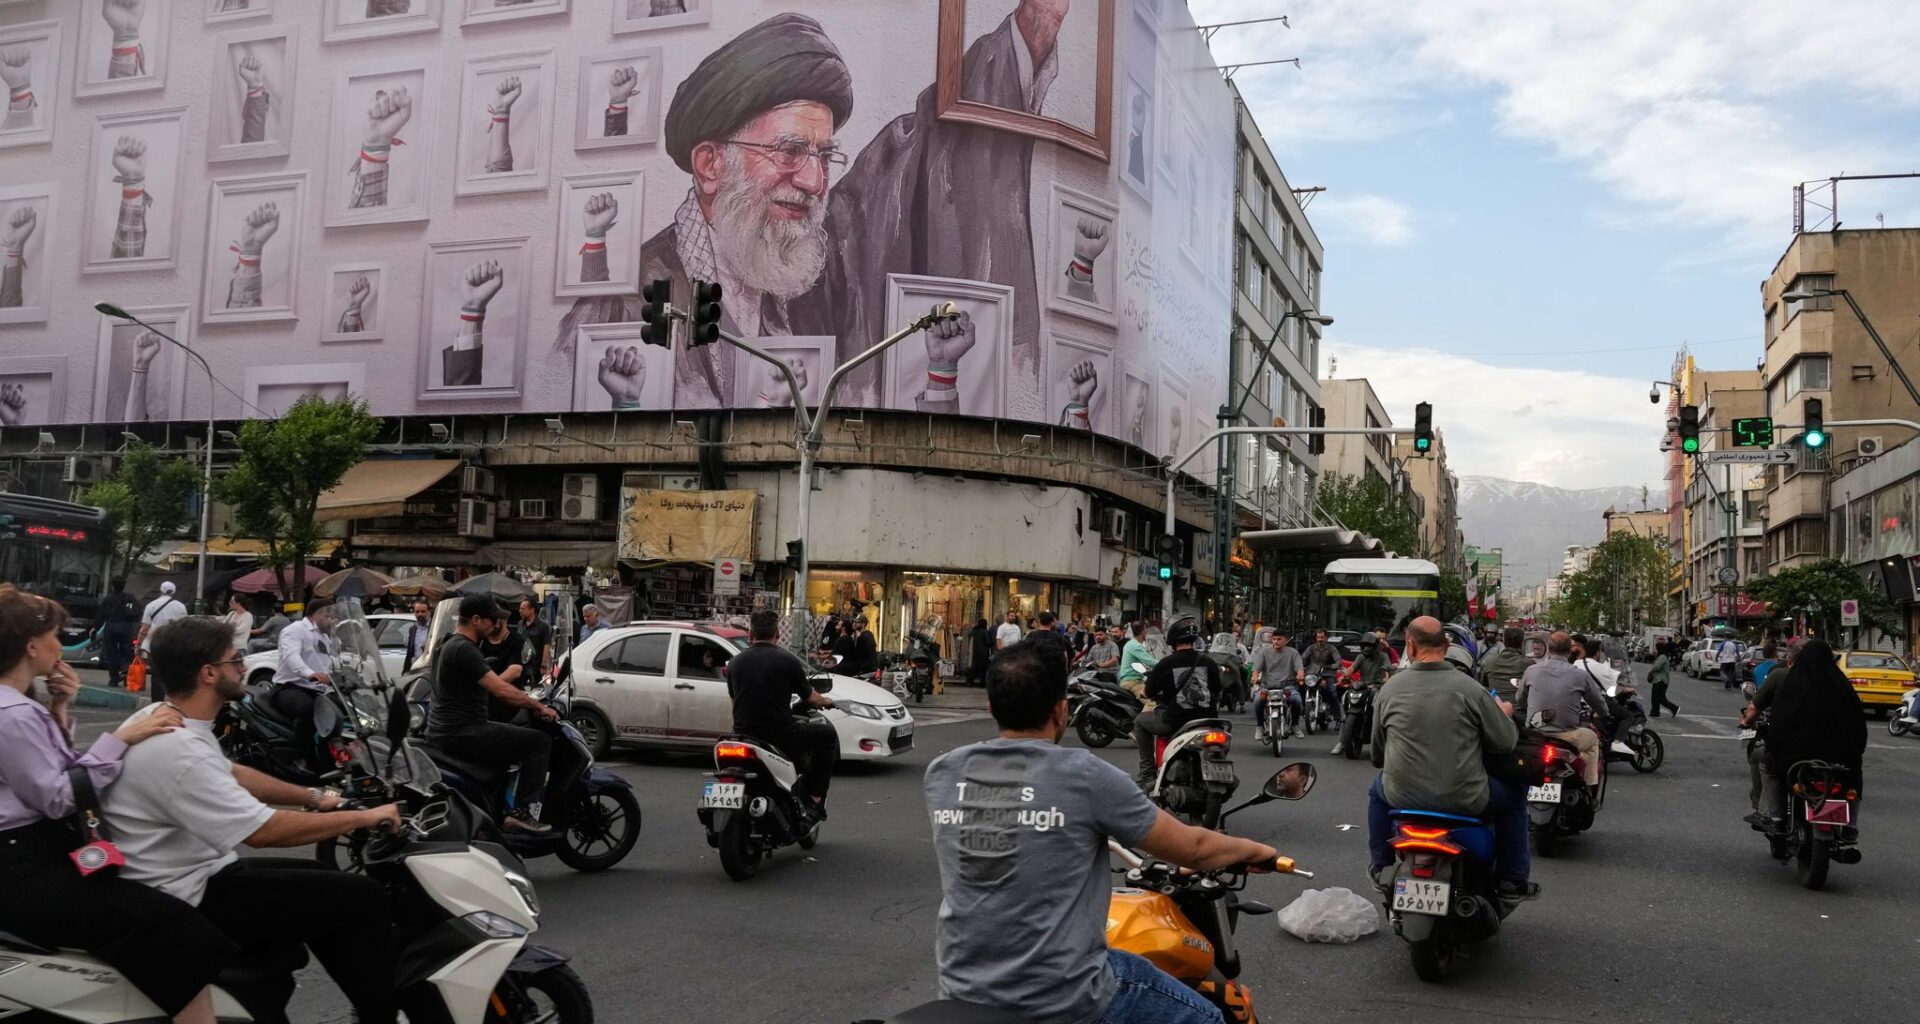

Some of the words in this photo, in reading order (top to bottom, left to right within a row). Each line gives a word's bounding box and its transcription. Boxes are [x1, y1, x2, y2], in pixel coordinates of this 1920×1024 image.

[1713, 453, 1738, 461] اسلامی
[710, 499, 724, 509] لاک
[724, 499, 745, 511] دنیای
[1415, 882, 1441, 896] ۱۴۴
[1396, 896, 1445, 911] ۵۶۵۷۳
